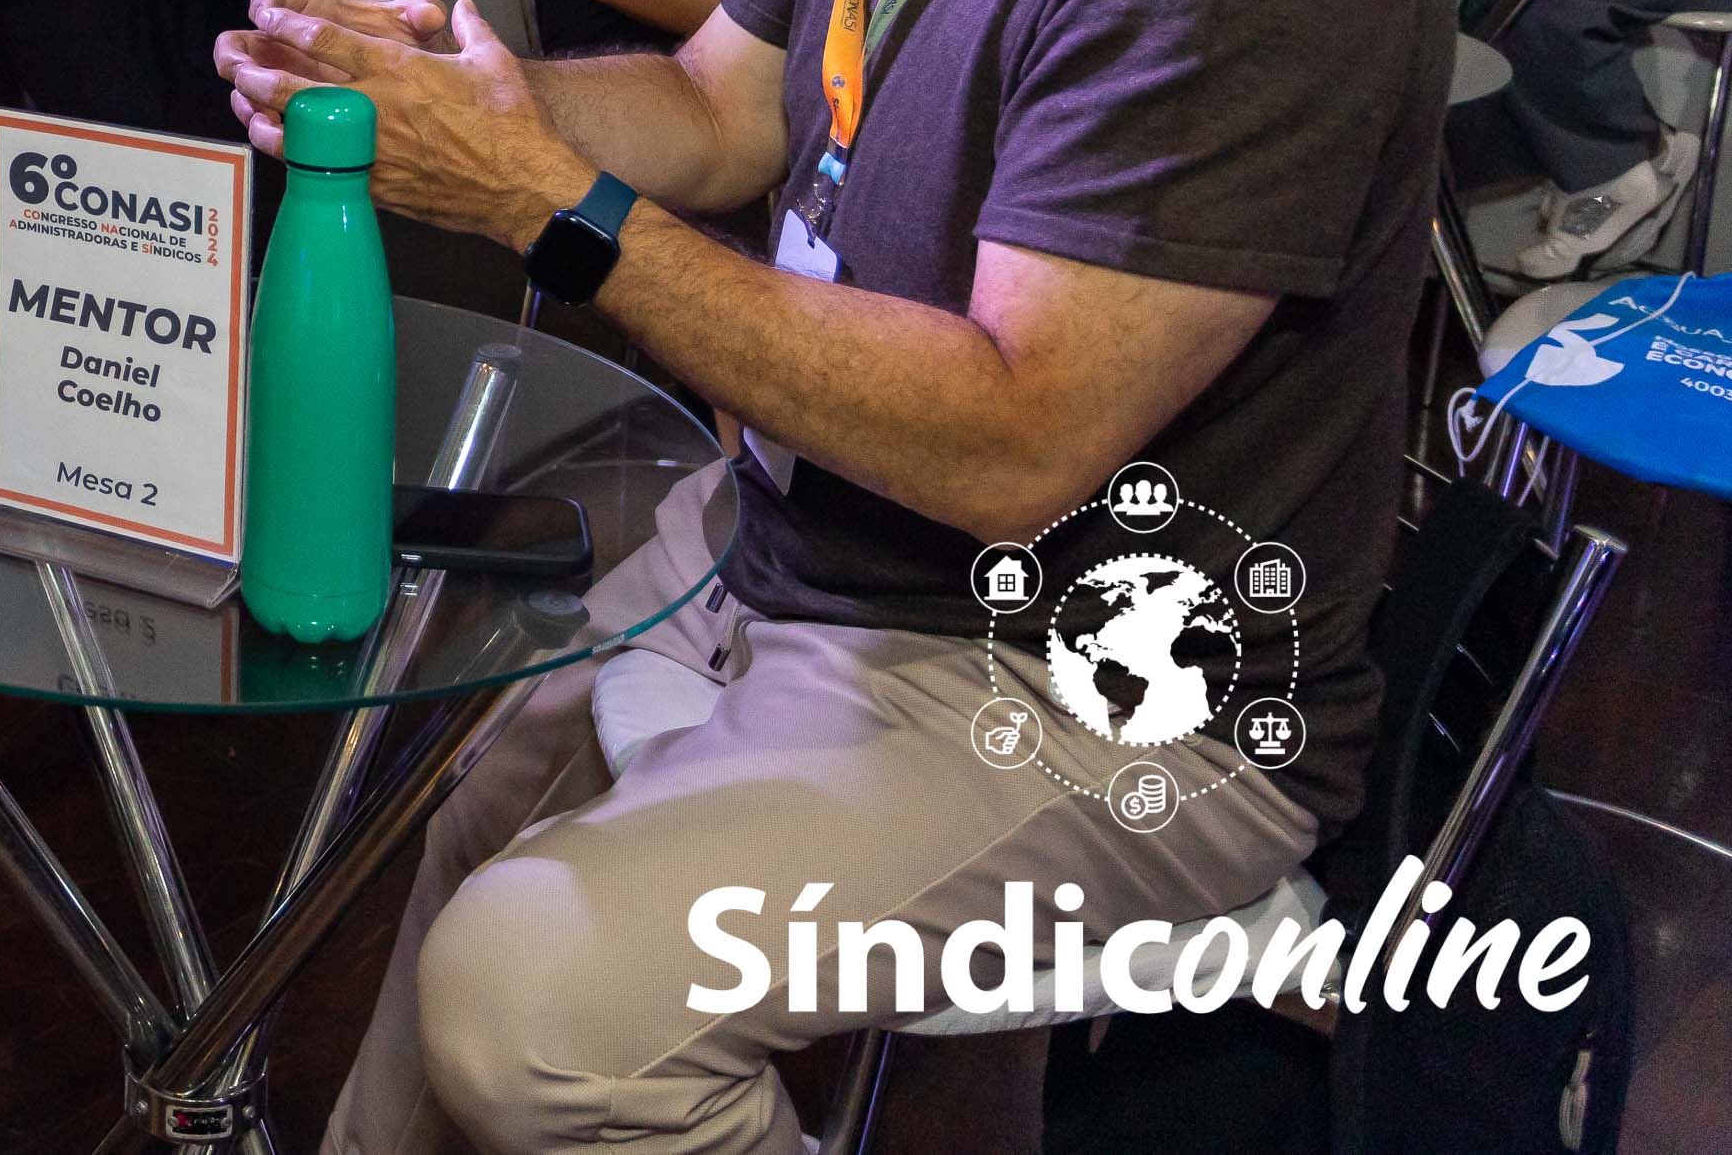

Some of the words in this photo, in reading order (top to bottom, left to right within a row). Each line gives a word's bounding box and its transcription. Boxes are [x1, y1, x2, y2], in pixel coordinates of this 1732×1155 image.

[23, 209, 98, 231] CONGRESSO
[101, 222, 166, 244] NACIONAL
[169, 236, 187, 247] DE
[54, 181, 203, 235] CONASI
[9, 219, 127, 250] ADMINISTRADORAS
[130, 241, 139, 252] E
[141, 242, 202, 264] SÍNDICOS
[207, 208, 219, 267] 2024
[9, 279, 217, 354] MENTOR
[60, 346, 160, 388] Daniel
[57, 380, 162, 422] Coelho
[56, 461, 133, 501] Mesa
[141, 483, 159, 507] 2
